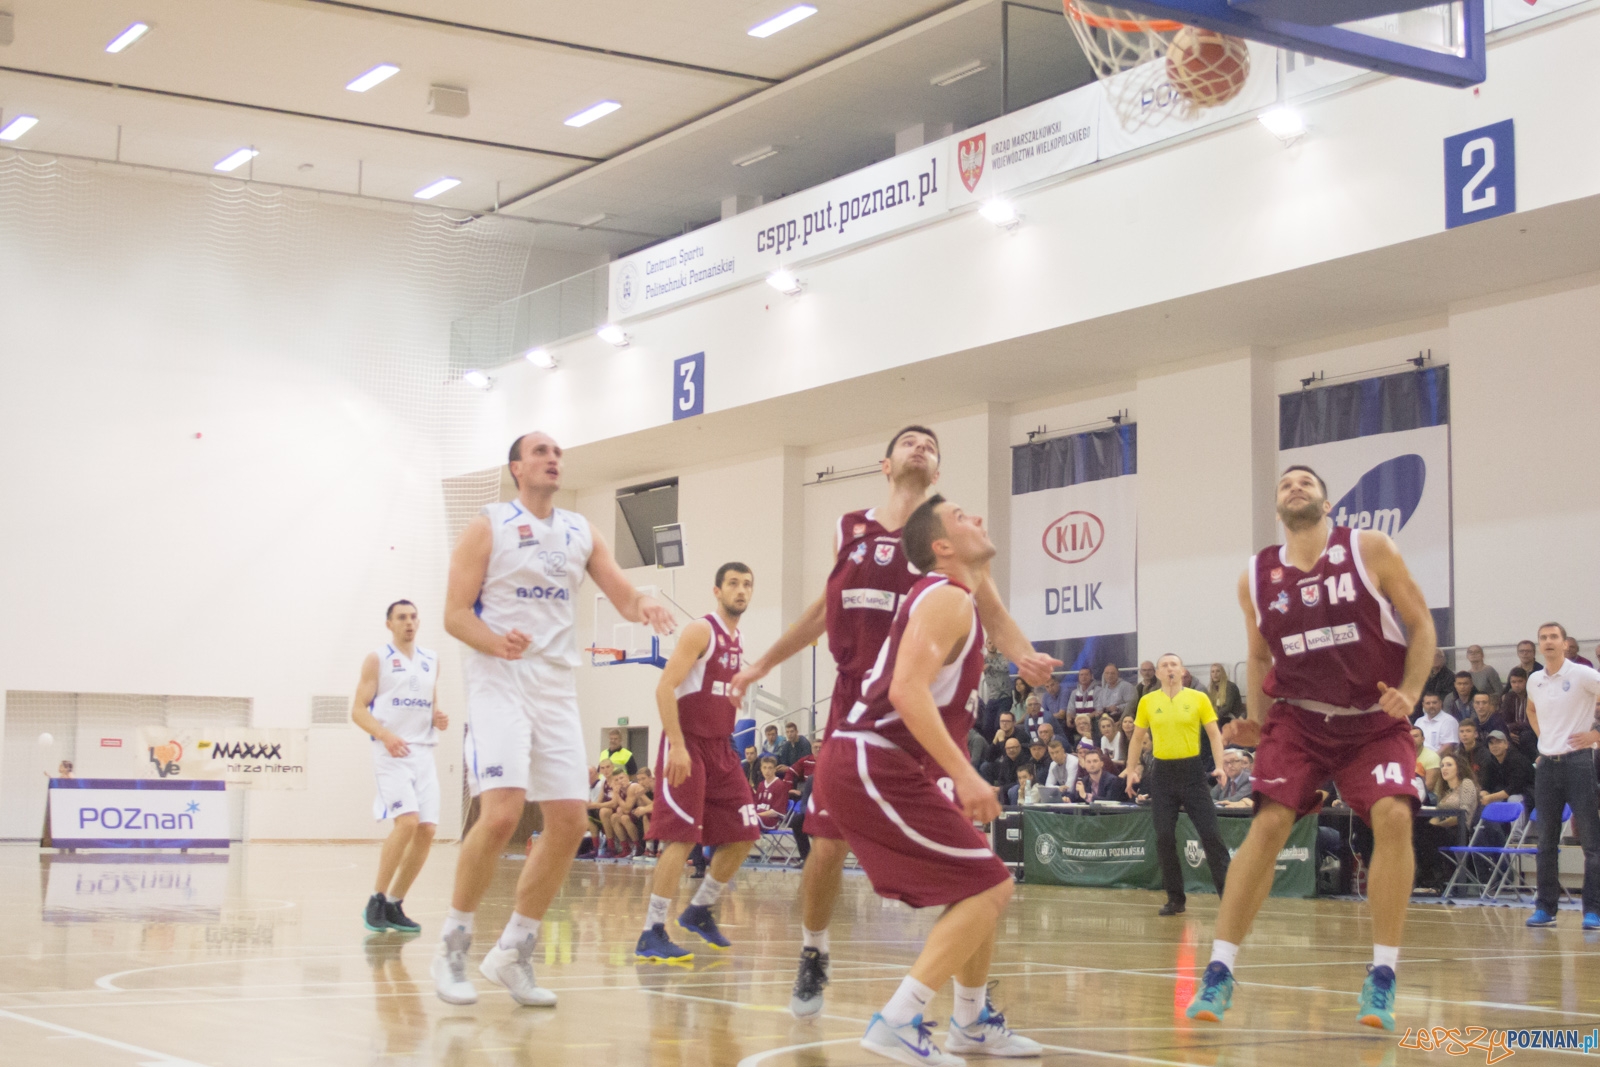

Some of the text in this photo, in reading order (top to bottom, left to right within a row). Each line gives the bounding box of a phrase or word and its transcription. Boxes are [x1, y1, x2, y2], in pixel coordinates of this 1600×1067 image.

[991, 121, 1061, 156] URZĄD MARSZAŁKOWSKI
[991, 126, 1091, 170] WOJEWÓDZTWA WIELKOPOLSKIEGO
[1462, 136, 1495, 214] 2
[757, 157, 938, 255] cspp.put.poznan.pl
[645, 245, 704, 275] Centrum Sportu
[645, 256, 735, 299] Politechniki Poznańskiej
[679, 361, 696, 412] 3
[1056, 521, 1094, 554] KIA
[538, 550, 567, 577] 12
[1045, 582, 1103, 616] DELIK
[1323, 572, 1356, 605] 14
[1283, 640, 1301, 652] PEC
[1307, 633, 1332, 646] MPGK
[212, 742, 281, 760] MAXXX
[227, 763, 303, 773] hit za hitem
[1371, 762, 1404, 785] 14
[79, 806, 194, 830] POZnan
[738, 803, 758, 827] 15
[1061, 845, 1145, 858] POLITECHNIKA POZNAŃSKA
